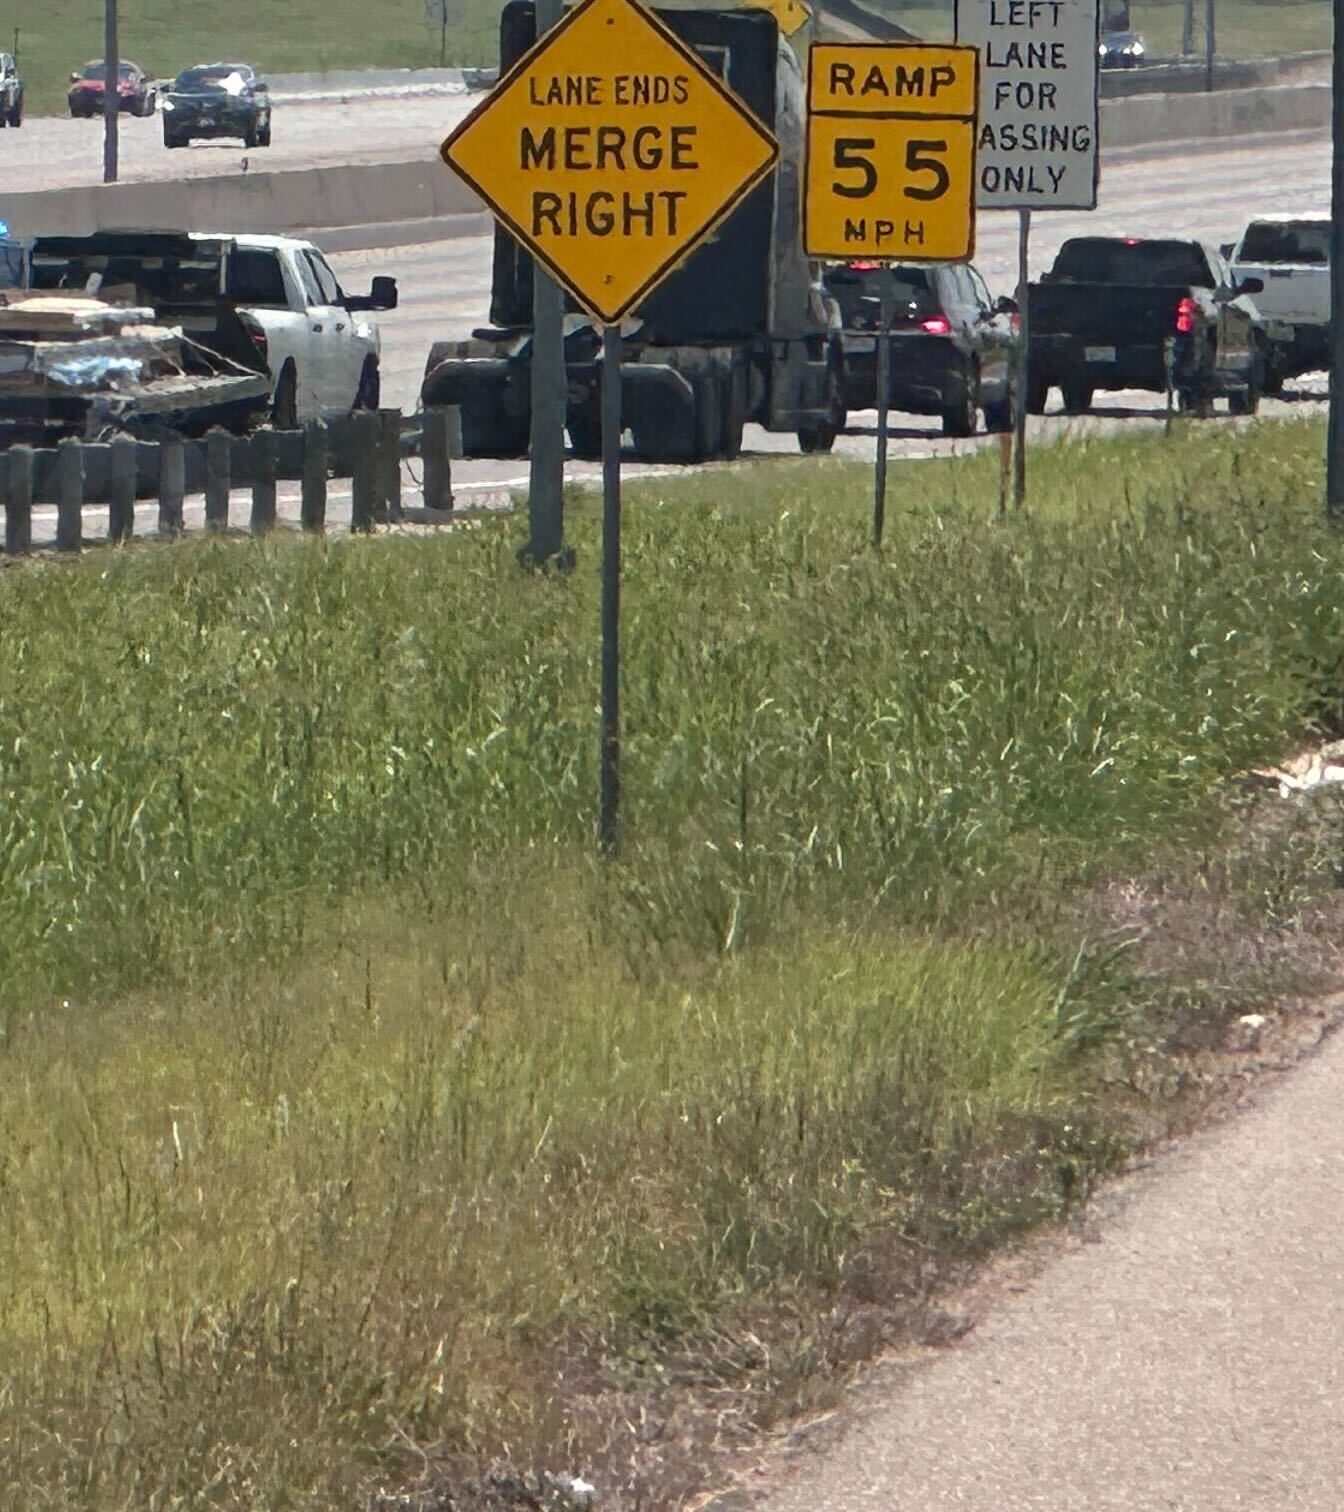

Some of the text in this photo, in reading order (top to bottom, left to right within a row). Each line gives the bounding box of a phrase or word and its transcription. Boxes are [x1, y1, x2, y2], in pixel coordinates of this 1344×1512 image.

[990, 1, 1064, 28] LEFT
[987, 42, 1067, 69] LANE
[530, 75, 688, 106] LANE ENDS
[830, 63, 955, 97] RAMP
[995, 82, 1057, 110] FOR
[521, 126, 698, 170] MERGE
[979, 124, 1090, 152] ASSING
[832, 138, 950, 201] 55
[981, 166, 1065, 193] ONLY
[533, 191, 687, 236] RIGHT
[845, 219, 923, 246] MPH
